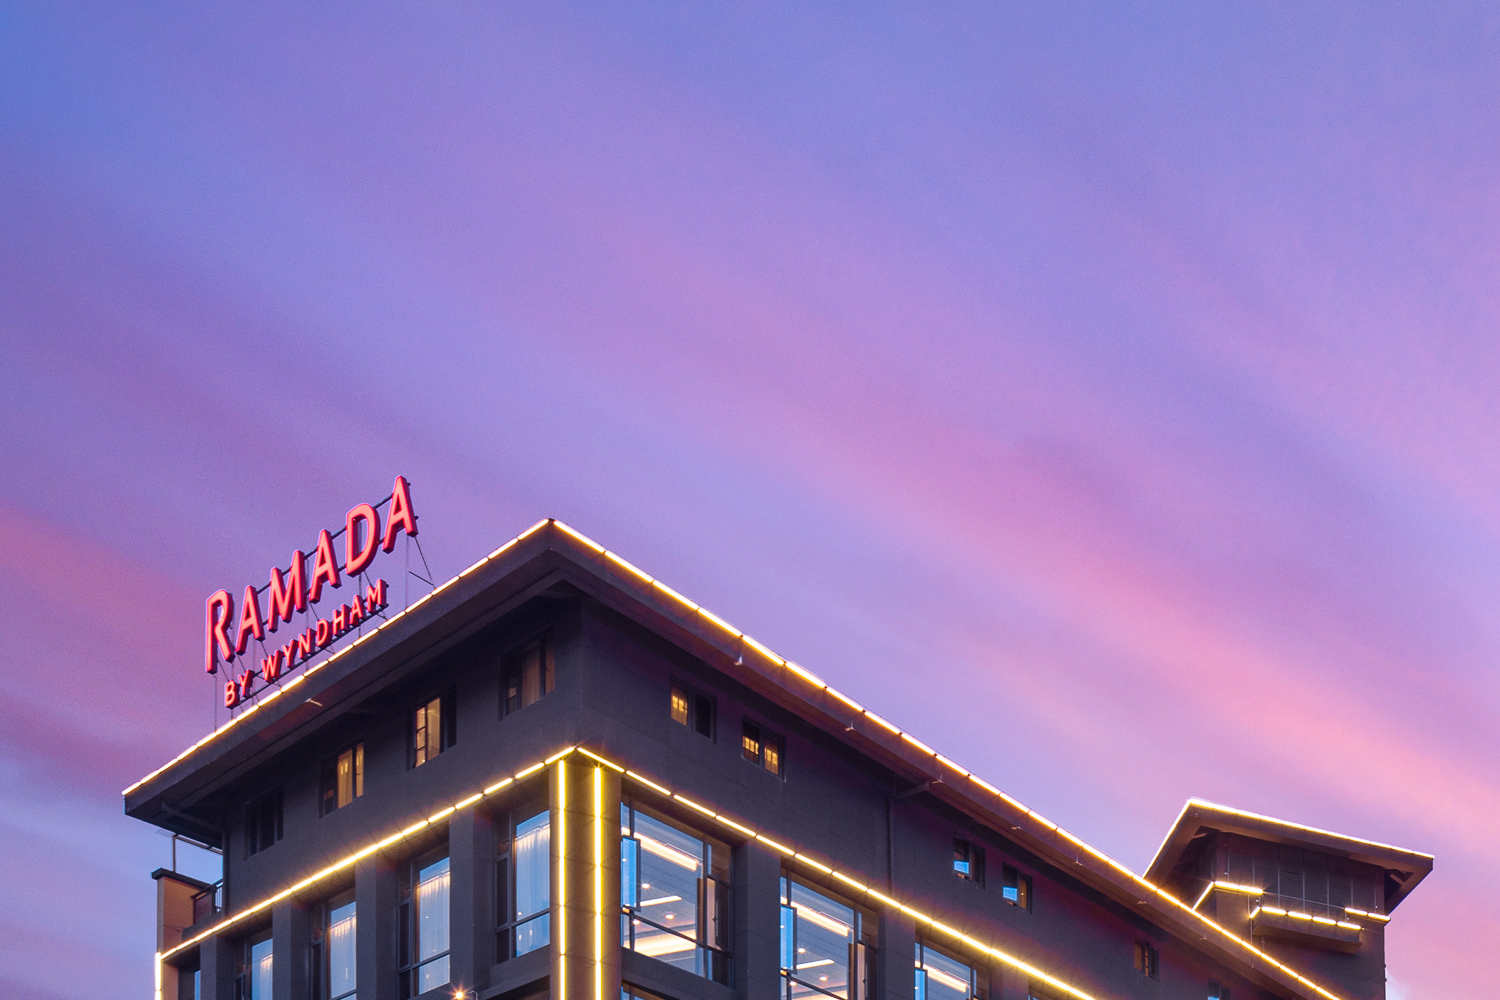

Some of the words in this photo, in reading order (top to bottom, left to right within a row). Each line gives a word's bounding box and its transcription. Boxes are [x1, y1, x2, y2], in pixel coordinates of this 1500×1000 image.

[206, 475, 418, 674] RAMADA
[225, 669, 254, 709] BY
[261, 578, 388, 683] WYNDHAM
